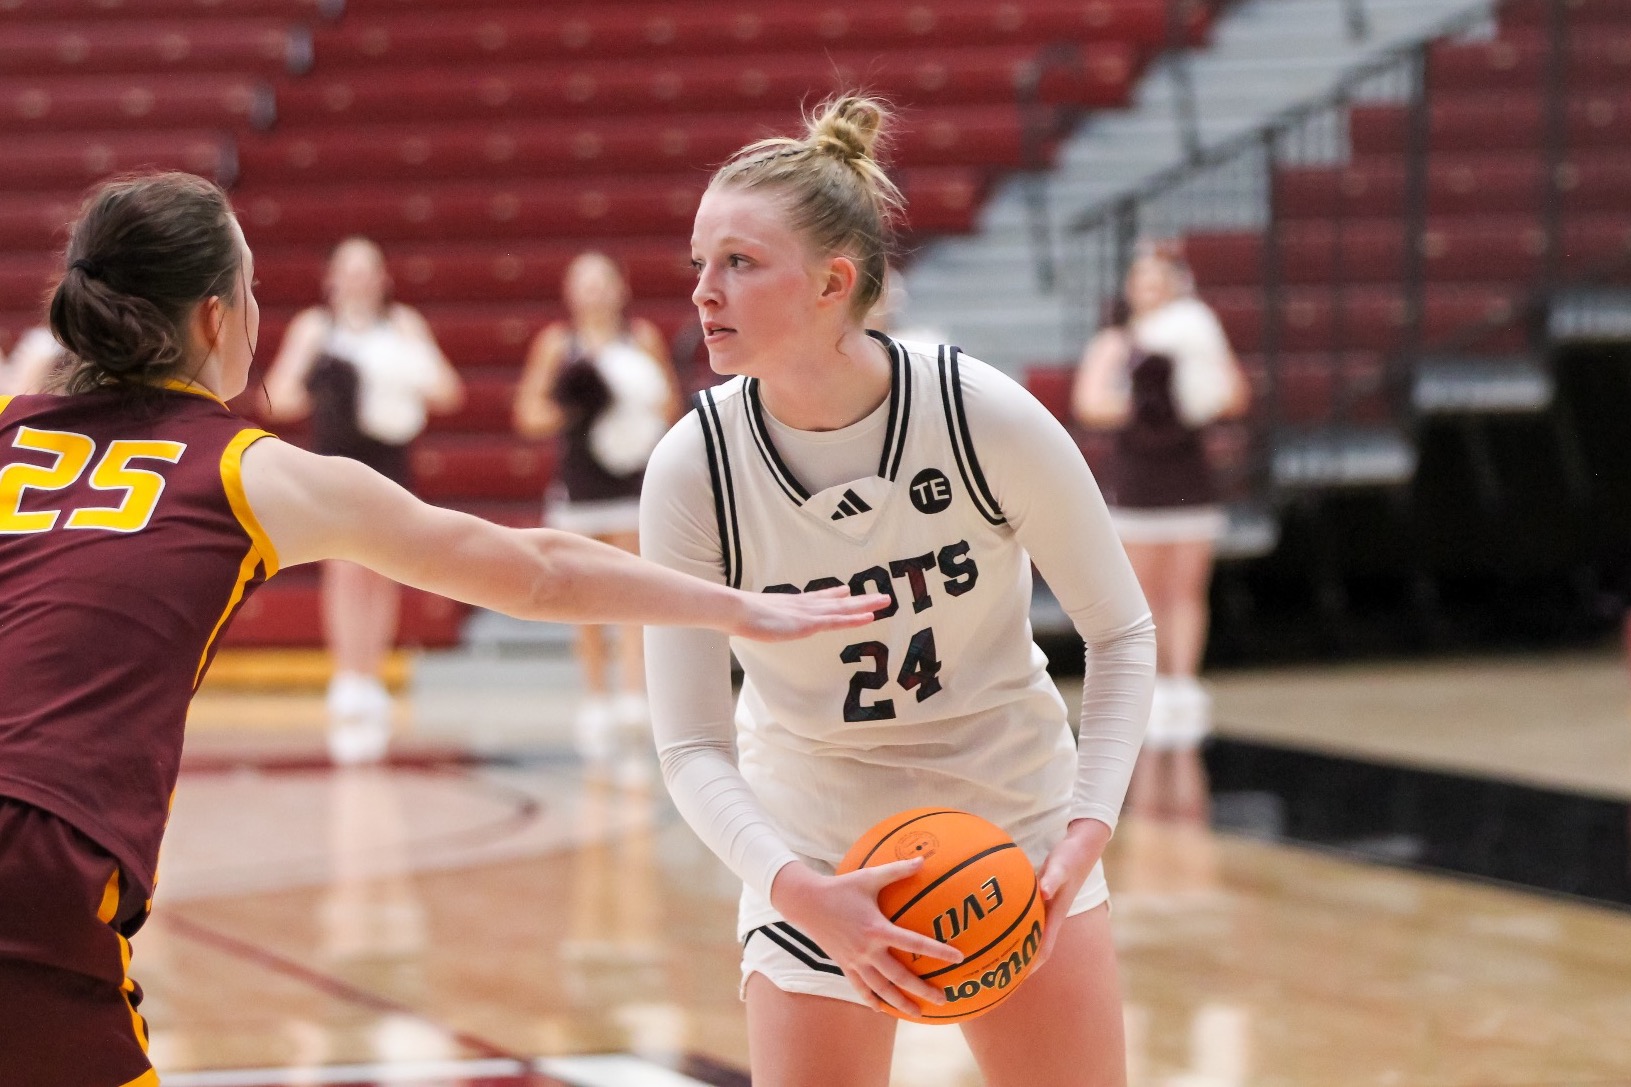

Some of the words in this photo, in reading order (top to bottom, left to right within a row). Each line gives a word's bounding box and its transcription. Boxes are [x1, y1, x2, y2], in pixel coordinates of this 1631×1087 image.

[0, 426, 188, 534] 25
[912, 477, 950, 505] TE
[761, 539, 979, 621] OTS
[839, 627, 943, 722] 24
